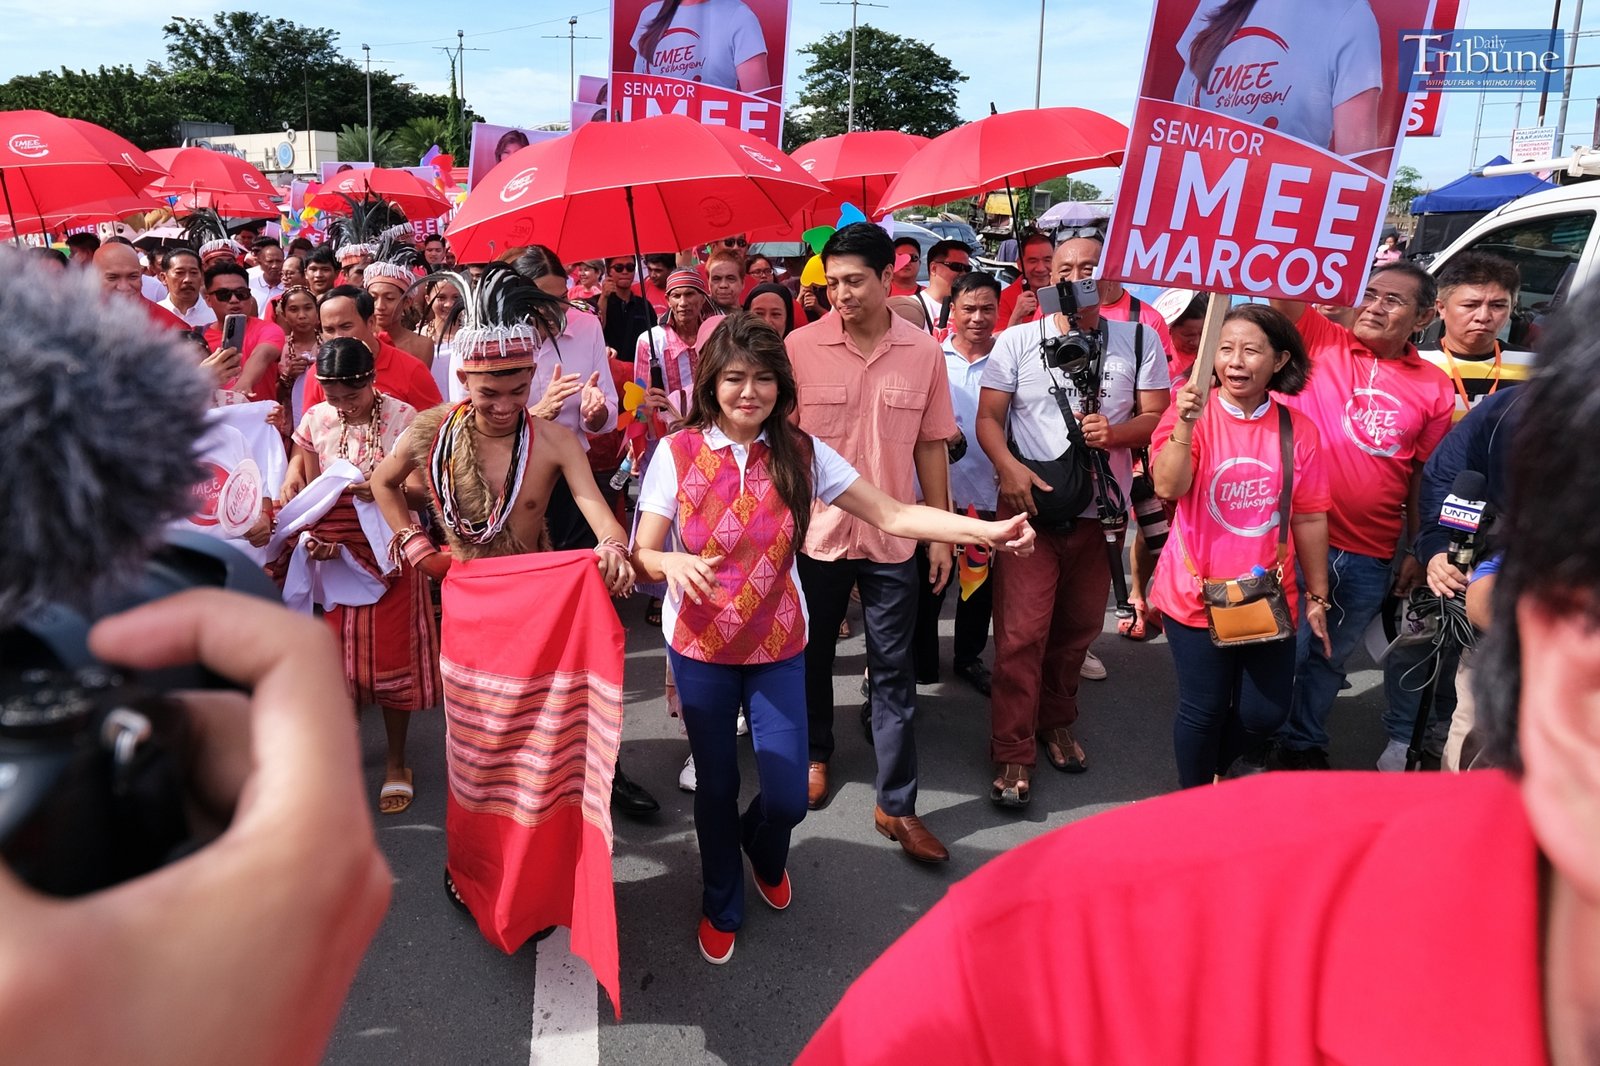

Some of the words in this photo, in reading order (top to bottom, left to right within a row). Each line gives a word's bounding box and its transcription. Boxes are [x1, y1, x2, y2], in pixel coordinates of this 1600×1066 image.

[653, 45, 696, 67] IMEE
[623, 82, 695, 98] SENATOR
[1206, 61, 1279, 95] IMEE
[1150, 118, 1264, 156] SENATOR
[1132, 145, 1369, 251] IMEE
[1120, 229, 1348, 300] MARCOS
[1220, 477, 1271, 502] IMEE
[1444, 507, 1478, 522] UNTV
